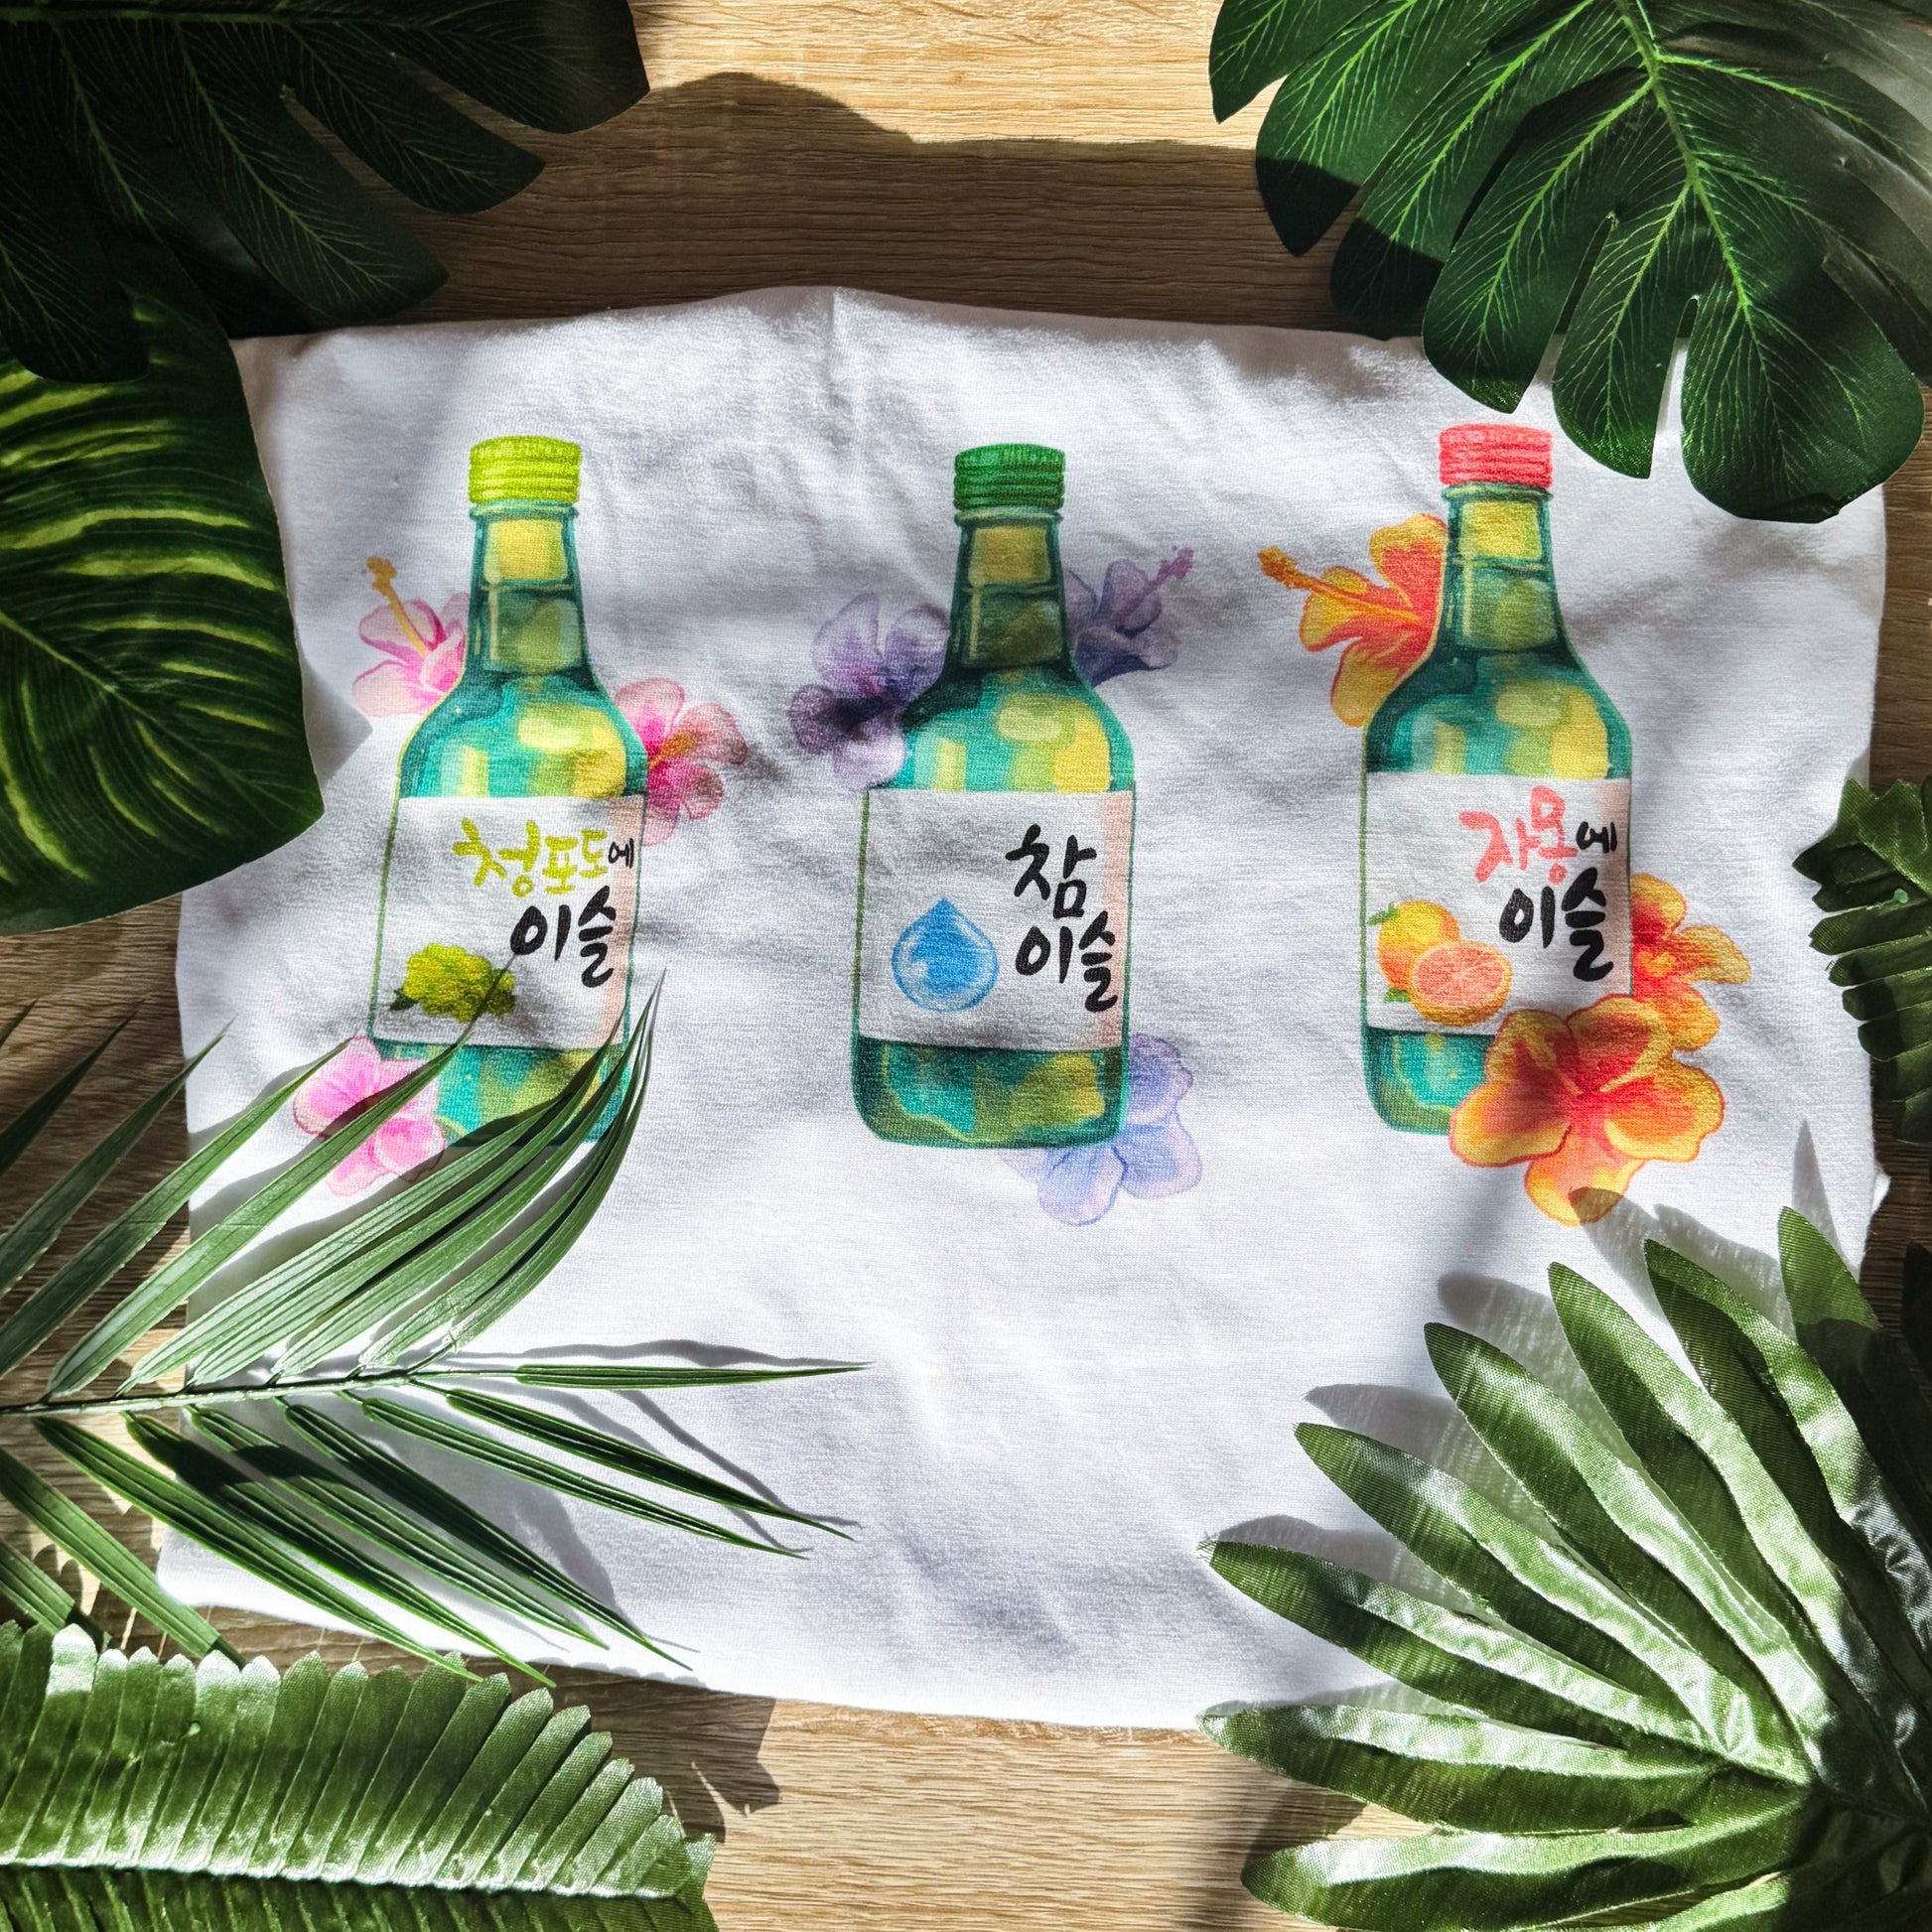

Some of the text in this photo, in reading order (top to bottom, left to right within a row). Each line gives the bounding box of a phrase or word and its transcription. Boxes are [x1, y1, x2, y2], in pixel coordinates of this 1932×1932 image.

[452, 817, 634, 897] 청포도에
[1005, 823, 1097, 918] 참
[509, 886, 617, 988] 이슬
[1015, 910, 1118, 1013] 이슬
[1498, 867, 1614, 982] 이슬
